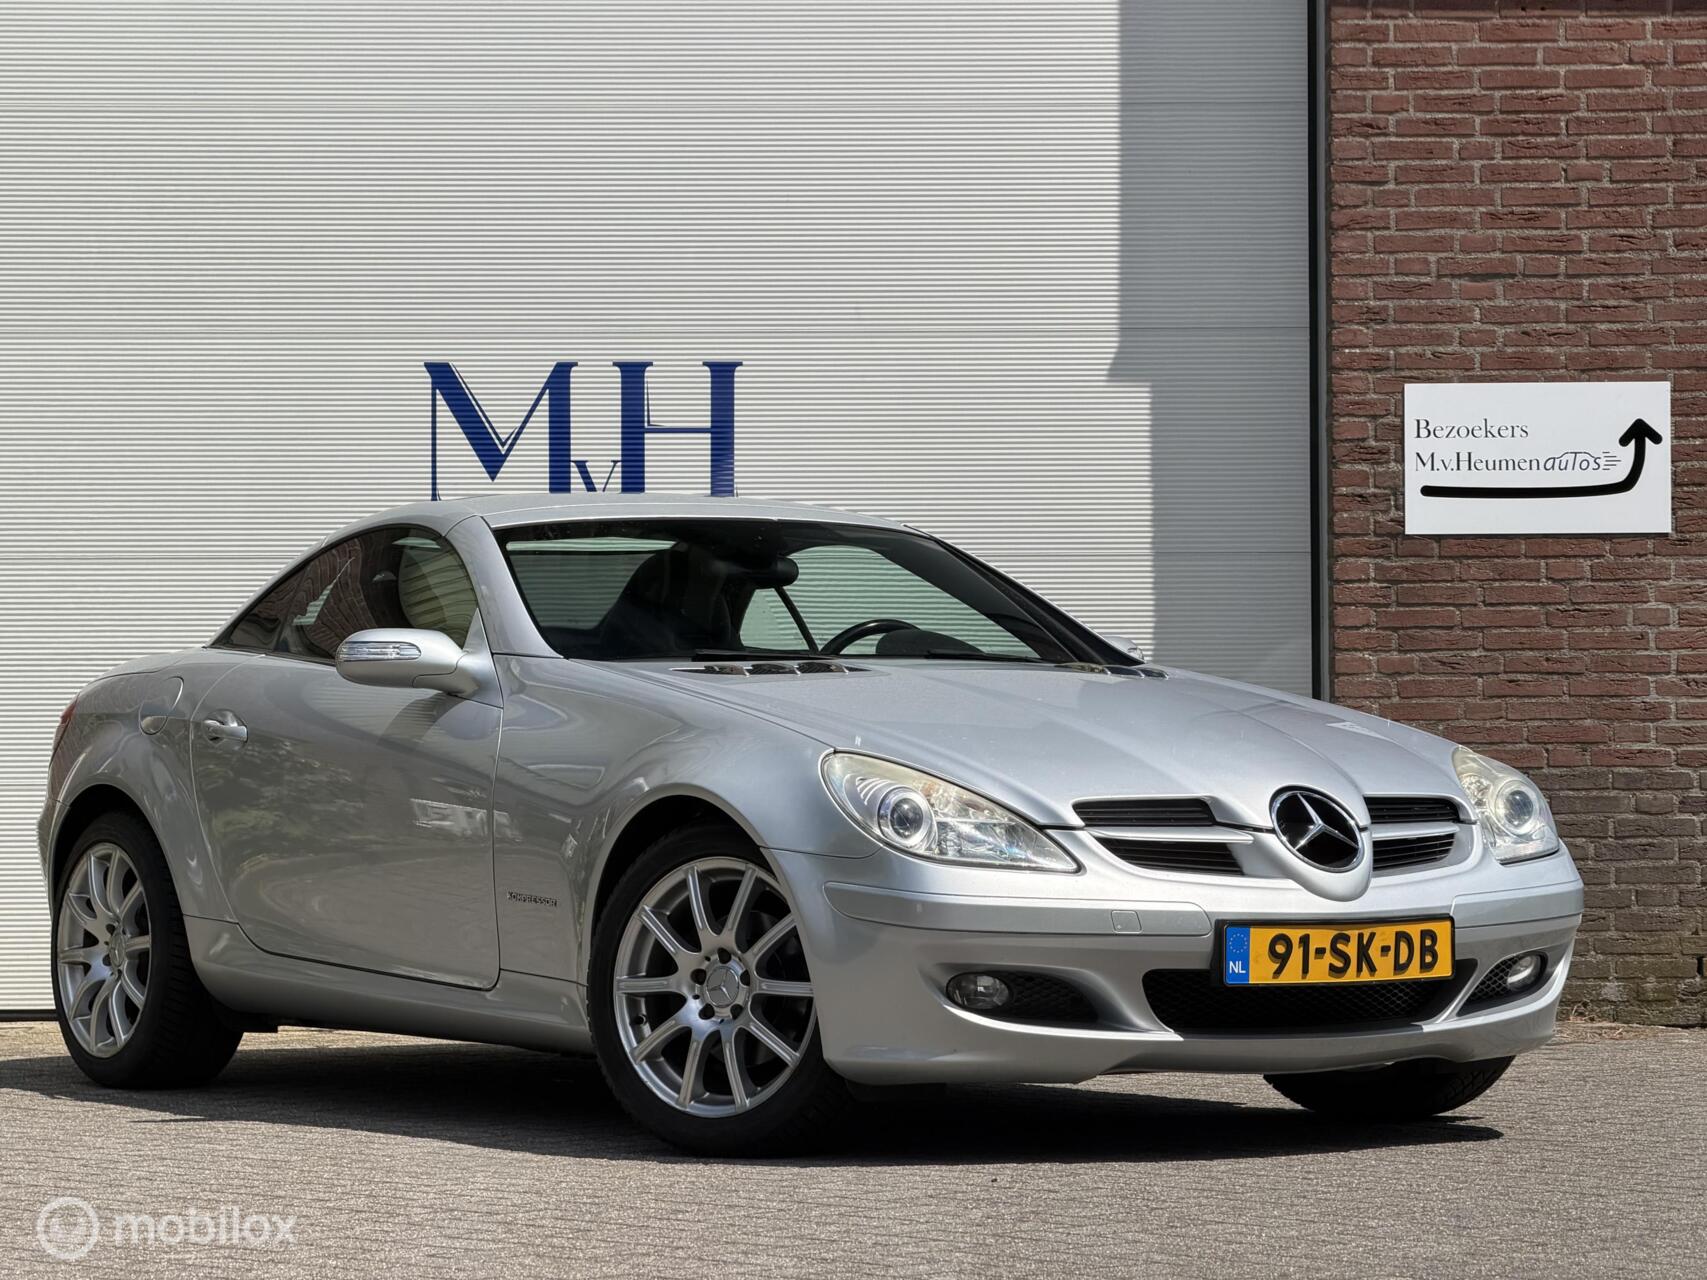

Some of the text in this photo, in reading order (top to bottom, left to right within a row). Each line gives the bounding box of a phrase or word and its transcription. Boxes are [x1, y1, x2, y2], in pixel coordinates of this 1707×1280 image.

[1415, 418, 1528, 439] Bezoekers
[1229, 928, 1439, 979] NL 91-SK-DB
